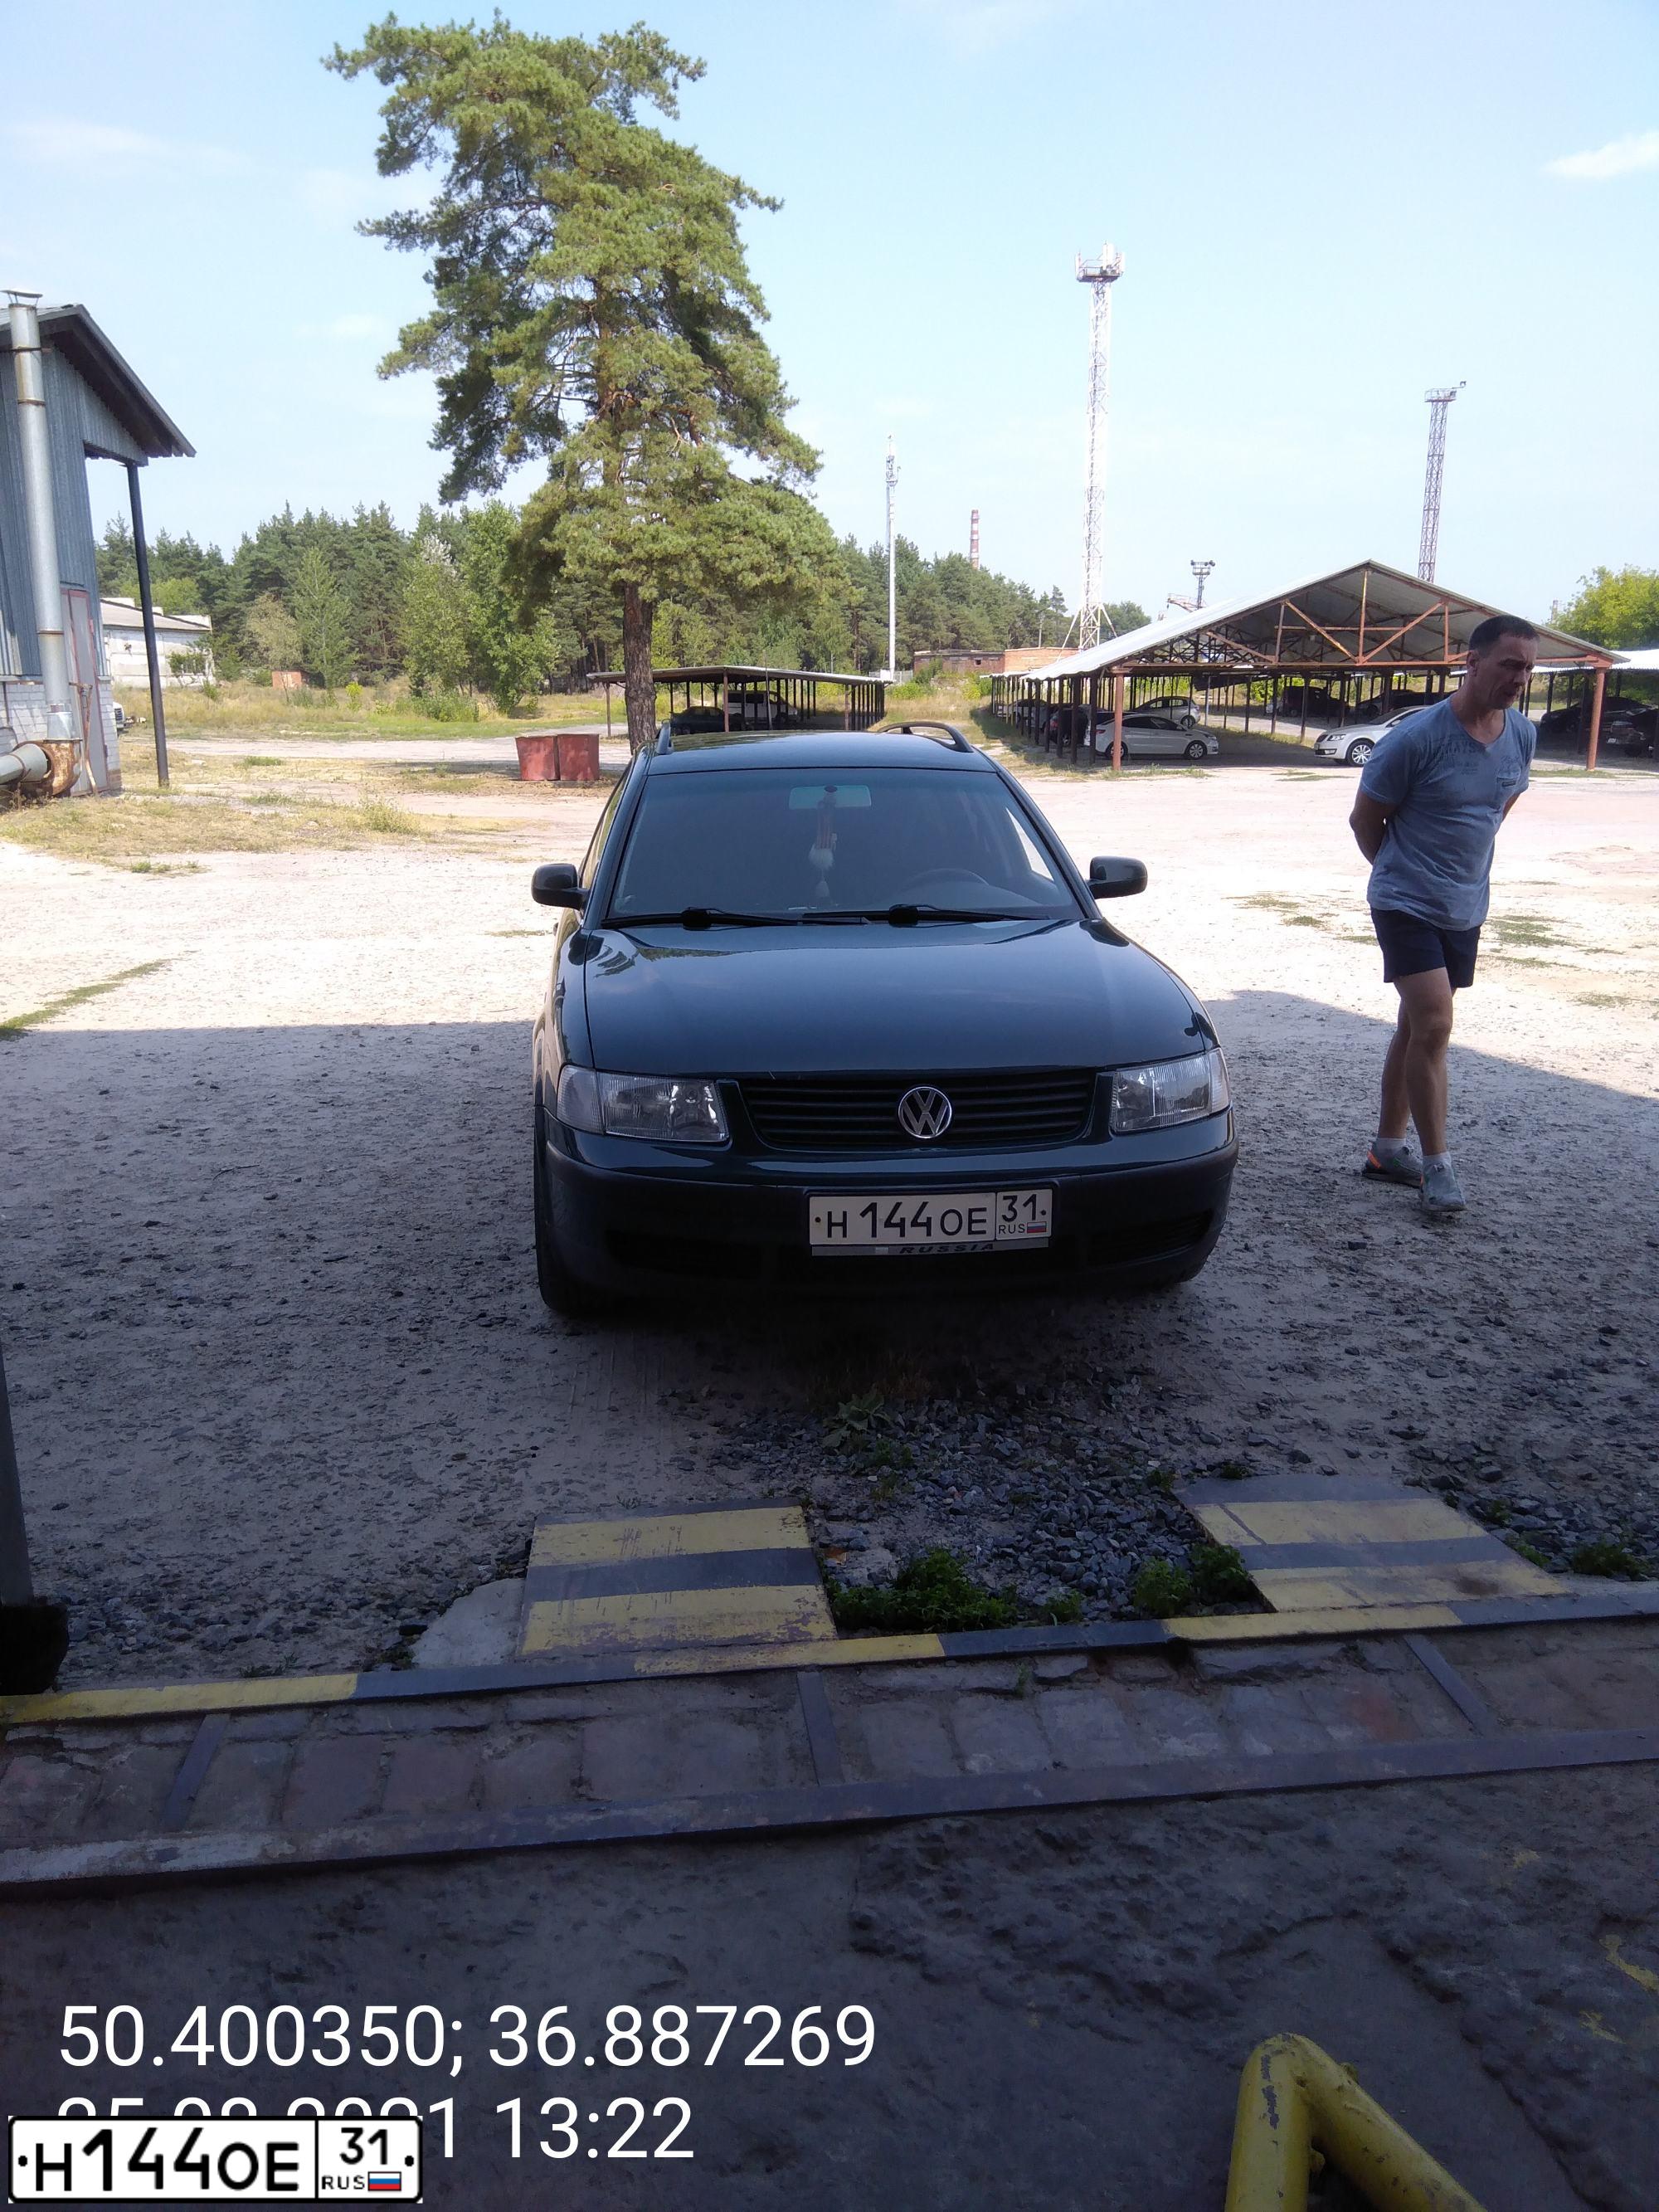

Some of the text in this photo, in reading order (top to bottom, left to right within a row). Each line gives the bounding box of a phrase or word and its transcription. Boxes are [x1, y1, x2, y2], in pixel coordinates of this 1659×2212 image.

[1001, 1194, 1037, 1222] 31
[998, 1223, 1025, 1235] RUS
[899, 1243, 994, 1255] RUSSIA
